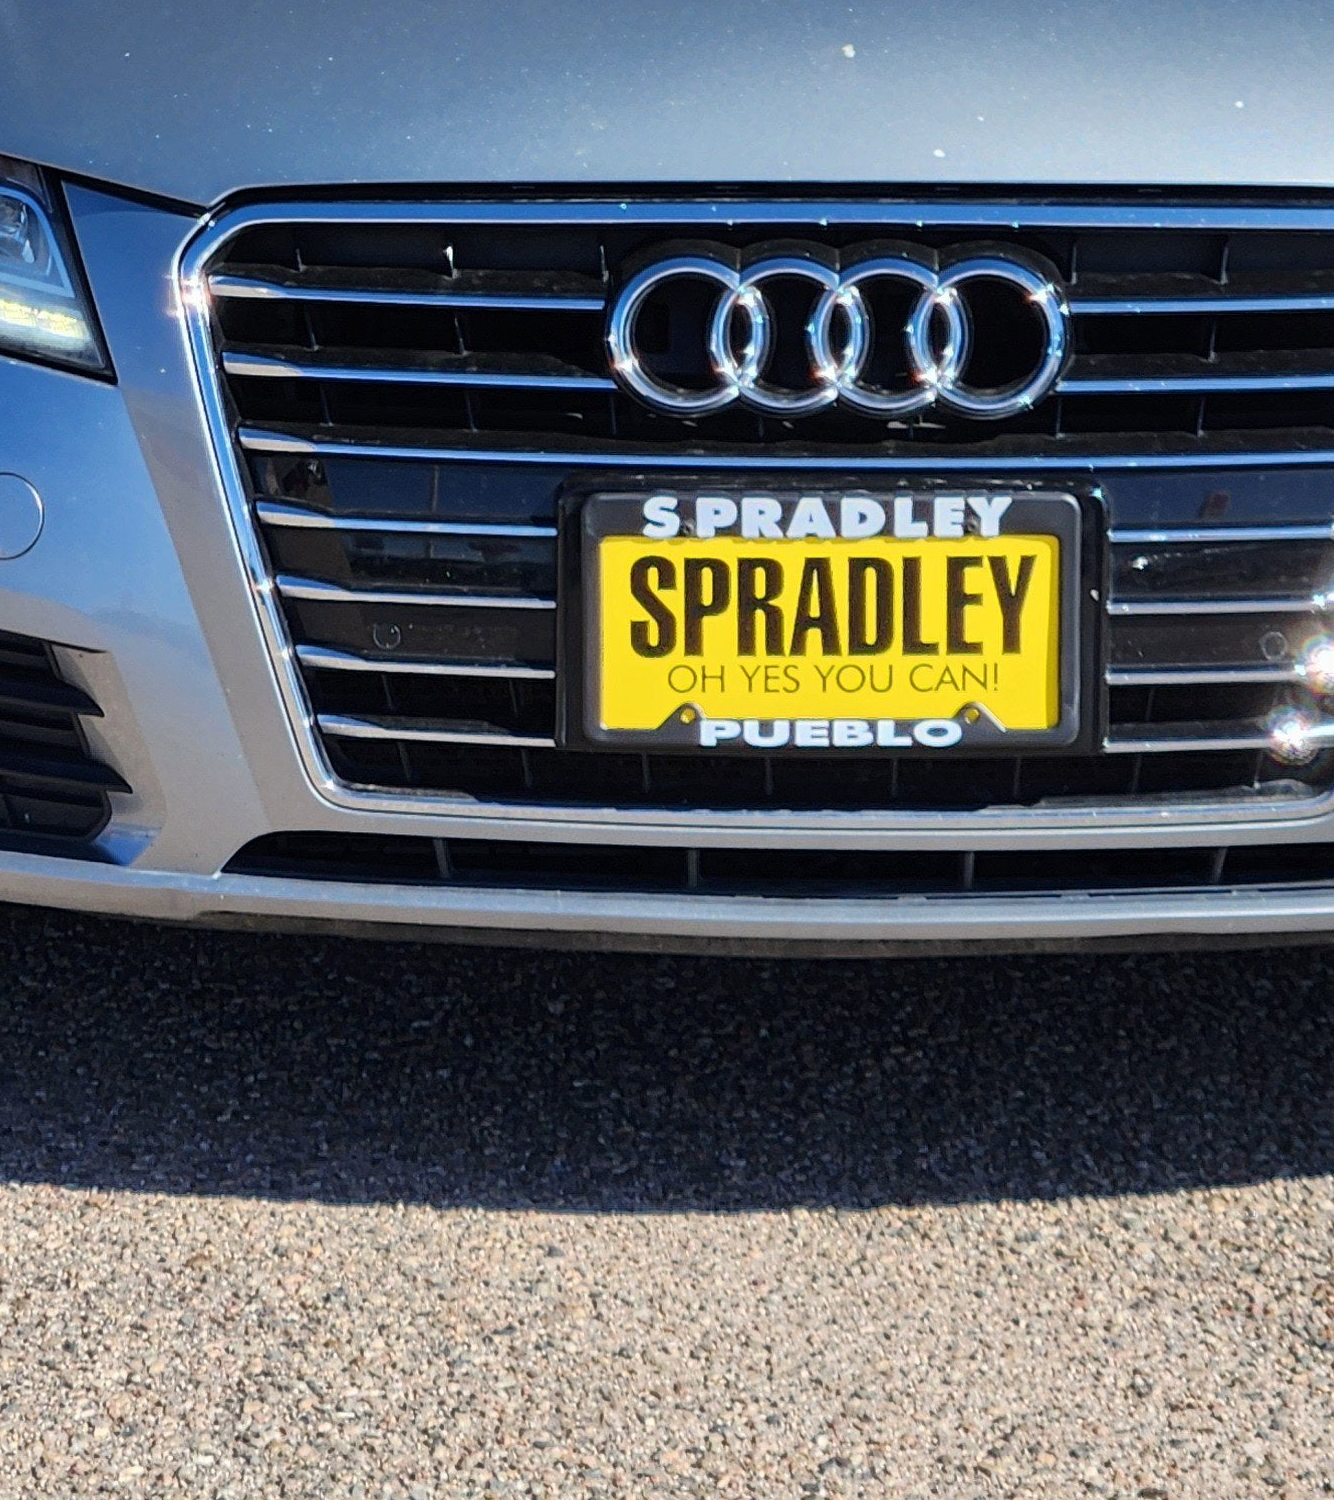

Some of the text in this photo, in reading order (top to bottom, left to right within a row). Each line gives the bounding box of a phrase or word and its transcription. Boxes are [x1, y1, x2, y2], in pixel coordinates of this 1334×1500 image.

[630, 555, 1037, 658] SPRADLEY
[668, 663, 1000, 692] OH YES YOU CAN!
[699, 719, 962, 748] PUEBLO
